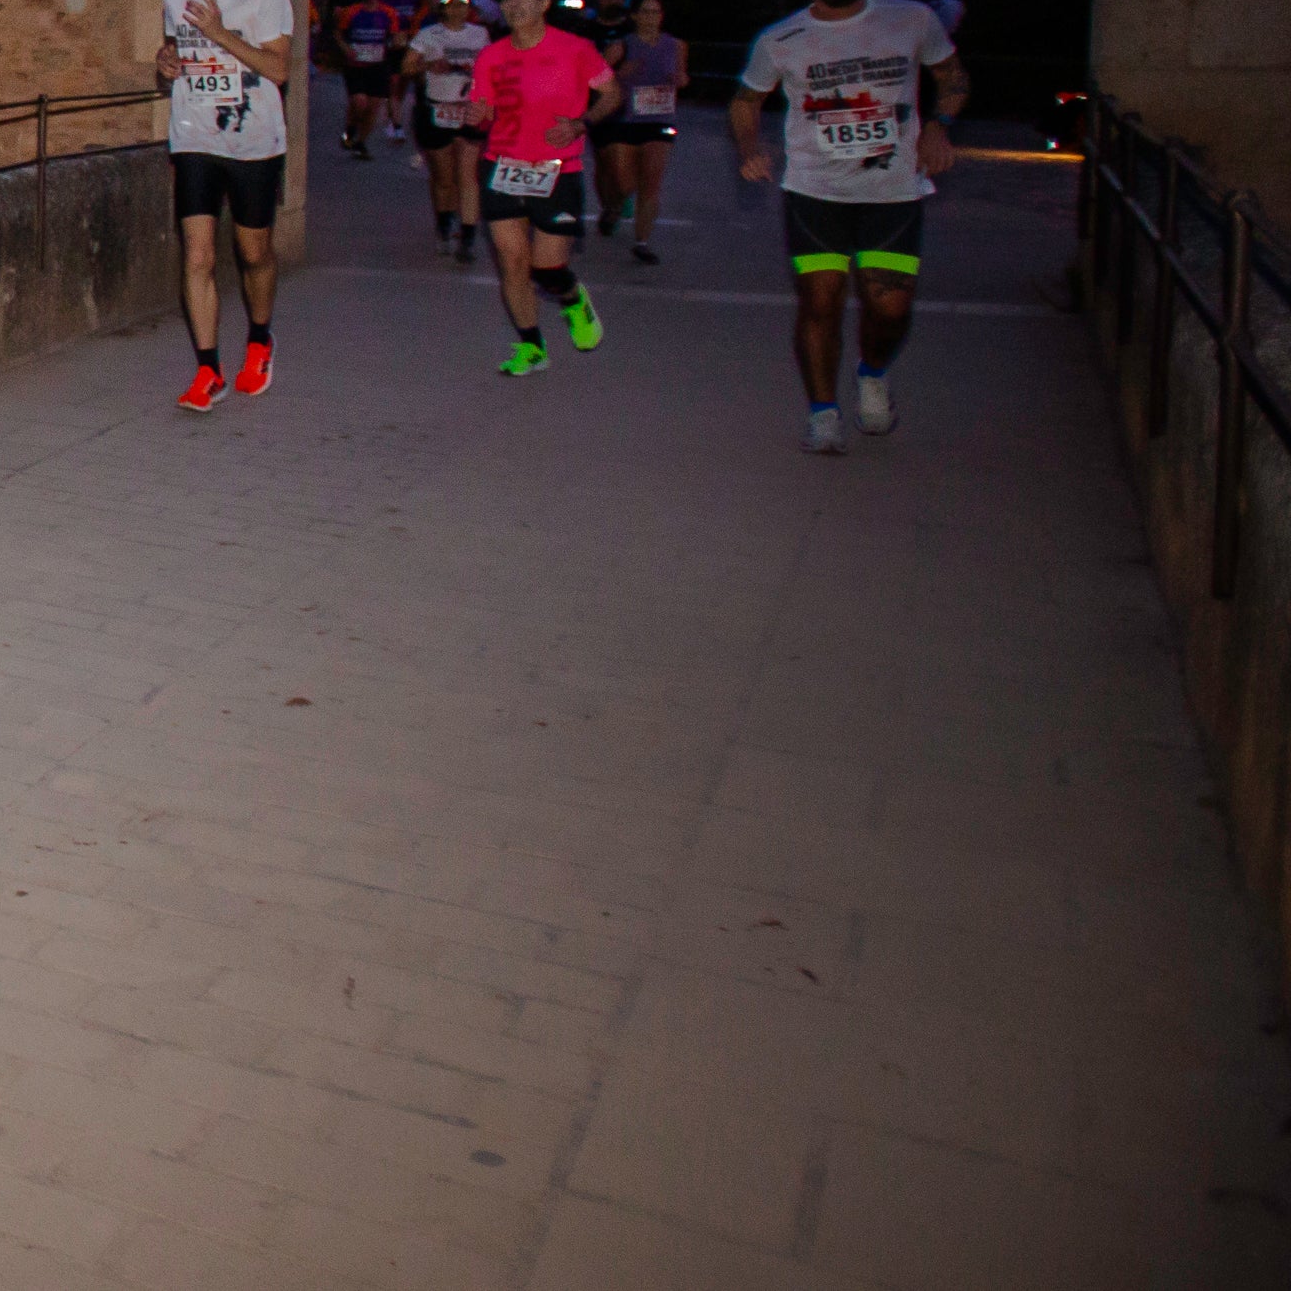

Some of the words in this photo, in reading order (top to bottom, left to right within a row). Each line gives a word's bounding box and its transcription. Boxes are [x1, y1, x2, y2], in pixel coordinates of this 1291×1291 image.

[807, 63, 826, 78] 40
[188, 76, 231, 92] 1493
[822, 121, 888, 144] 1855
[499, 167, 548, 186] 1267
